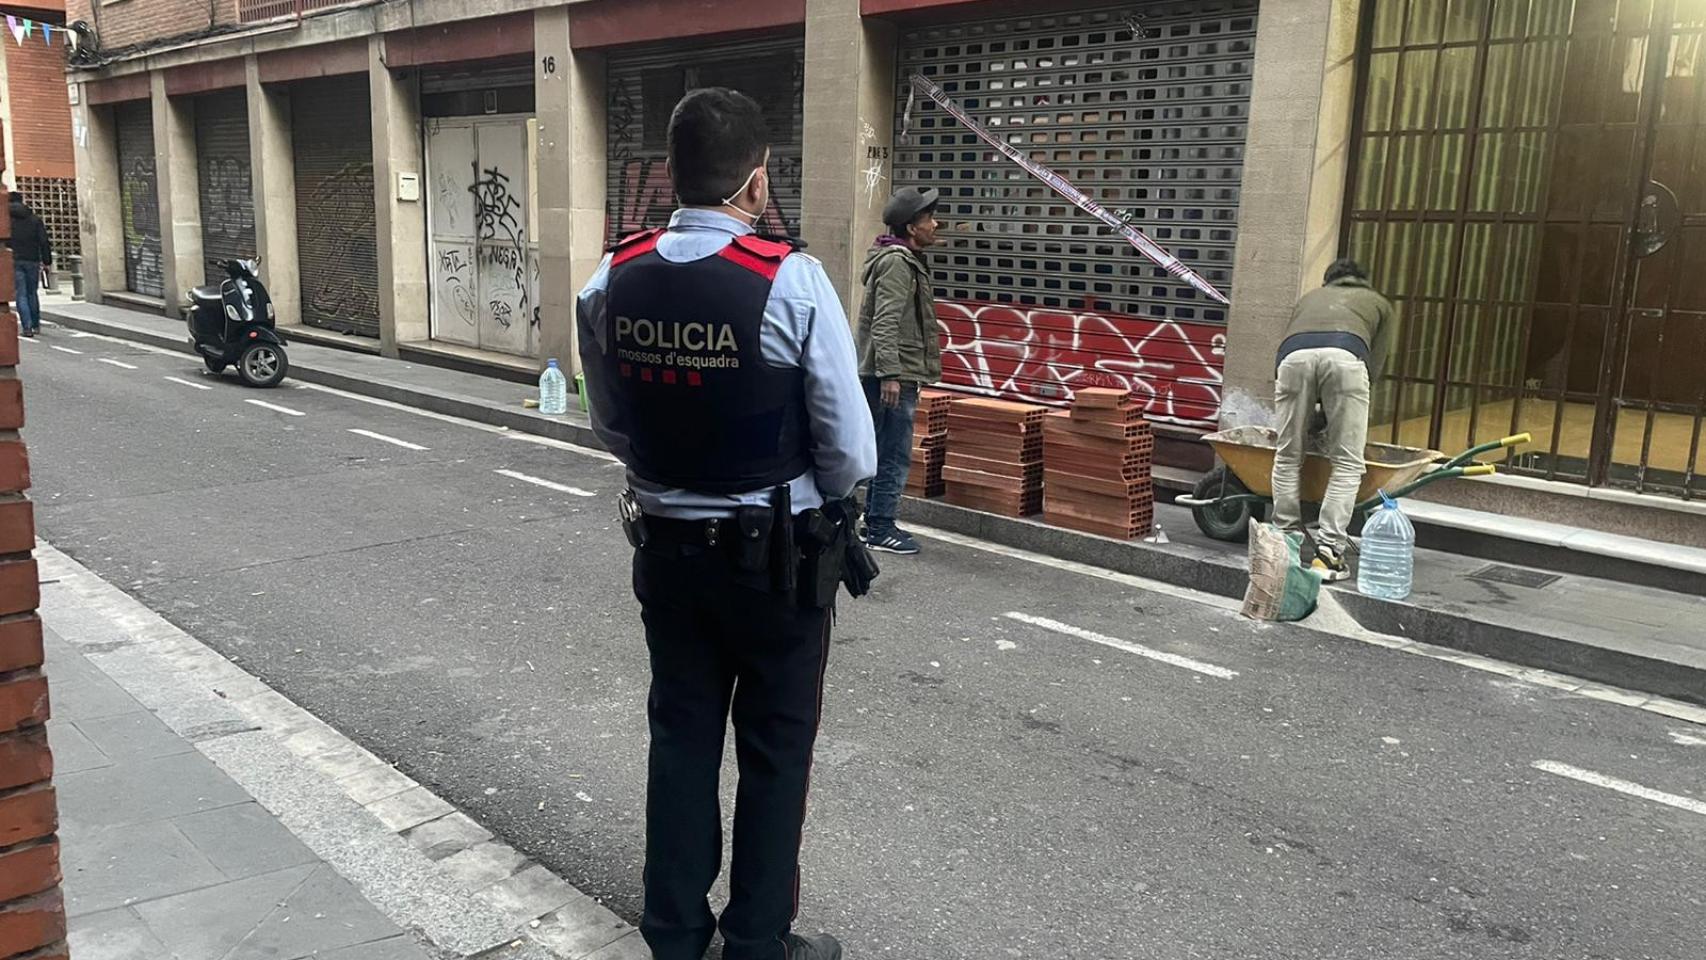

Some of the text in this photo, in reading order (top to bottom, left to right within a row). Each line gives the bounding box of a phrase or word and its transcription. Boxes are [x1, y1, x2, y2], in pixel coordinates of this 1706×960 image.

[542, 56, 555, 74] 16
[615, 316, 739, 352] POLICIA
[617, 348, 740, 369] mossos d'esquadra
